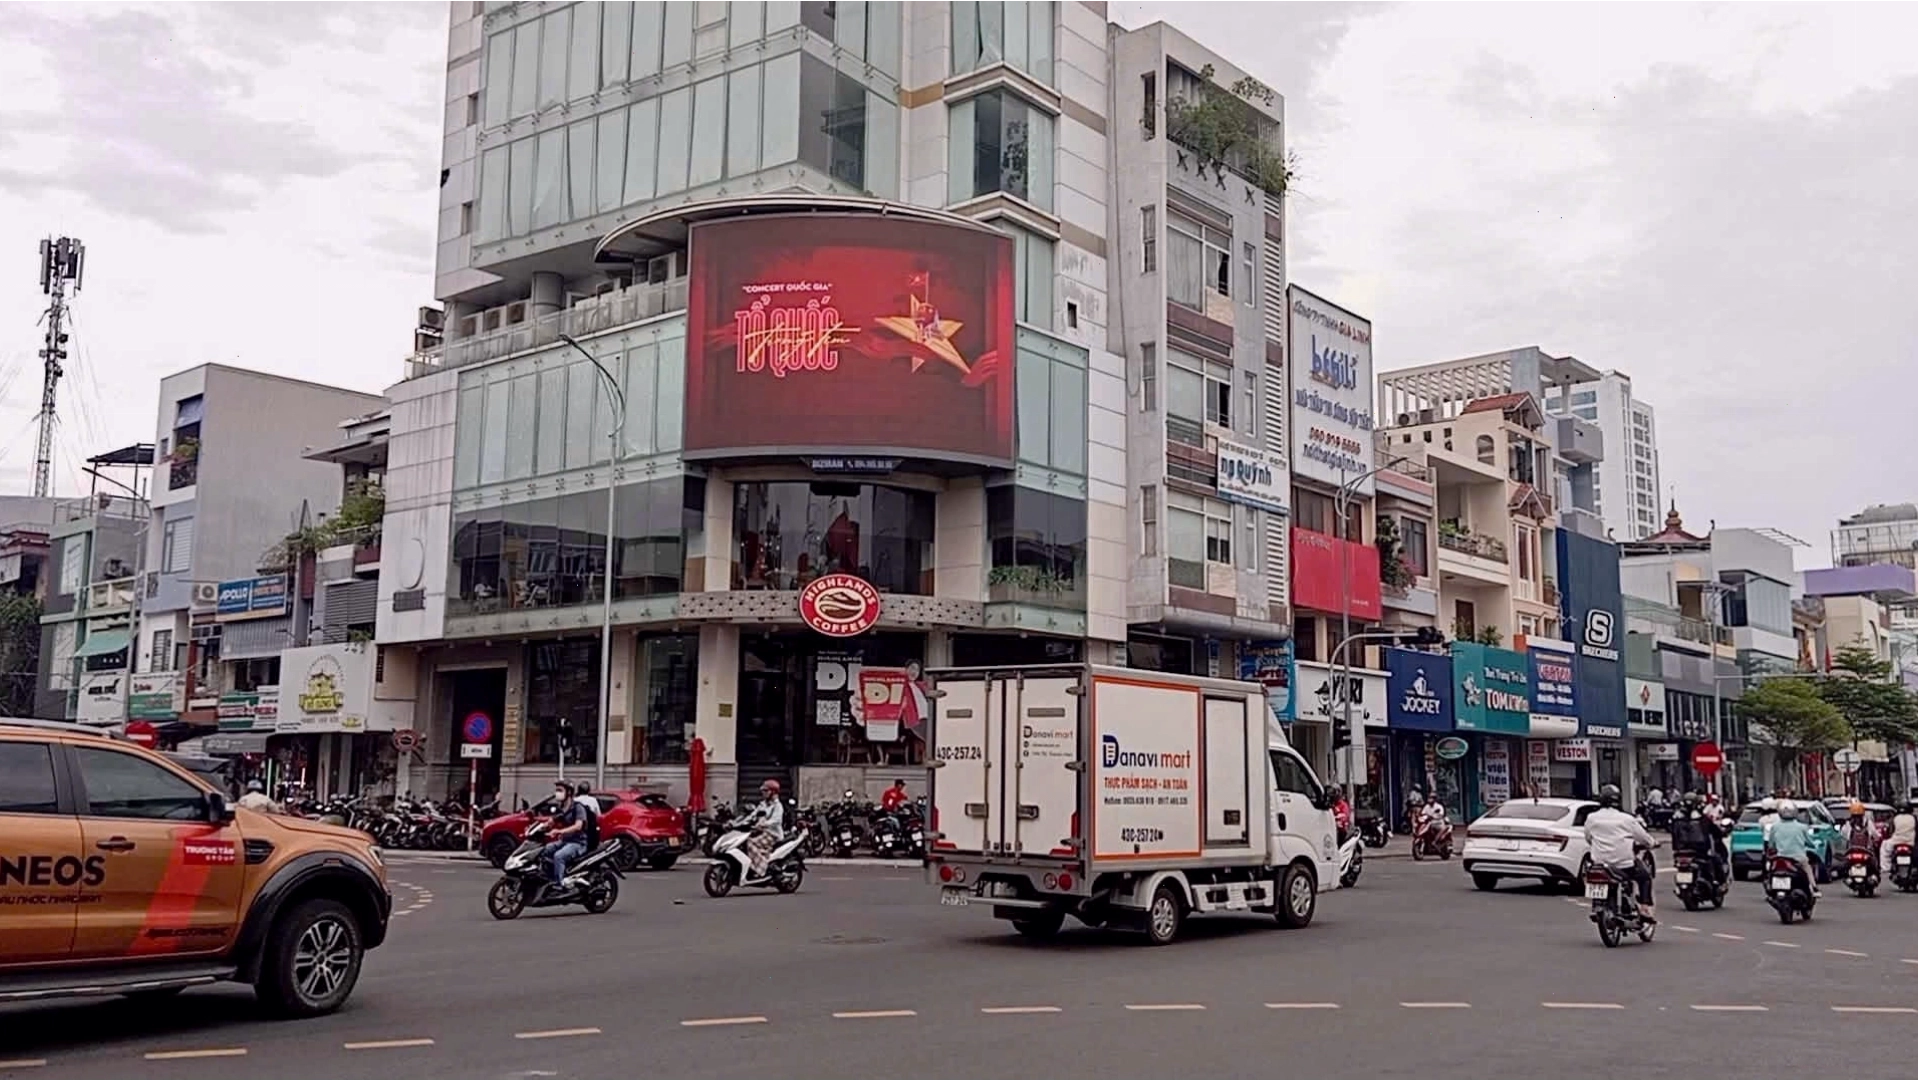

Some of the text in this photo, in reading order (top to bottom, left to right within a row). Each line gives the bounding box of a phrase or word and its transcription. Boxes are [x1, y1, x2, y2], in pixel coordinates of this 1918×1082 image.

[786, 281, 811, 292] QUỐC
[735, 294, 839, 378] TỔ QUỐC
[804, 577, 877, 605] HIGHLANDS
[812, 616, 867, 634] COFFEE
[1582, 644, 1619, 661] SKECHERS
[1401, 696, 1441, 714] JOCKEY
[1023, 725, 1074, 739] Danavi mart
[1587, 725, 1622, 738] SKECHERS
[1102, 734, 1158, 769] Danavi
[1160, 749, 1191, 769] mart
[1556, 747, 1588, 759] VESTON
[205, 854, 235, 862] GROUP
[0, 856, 106, 886] NEOS
